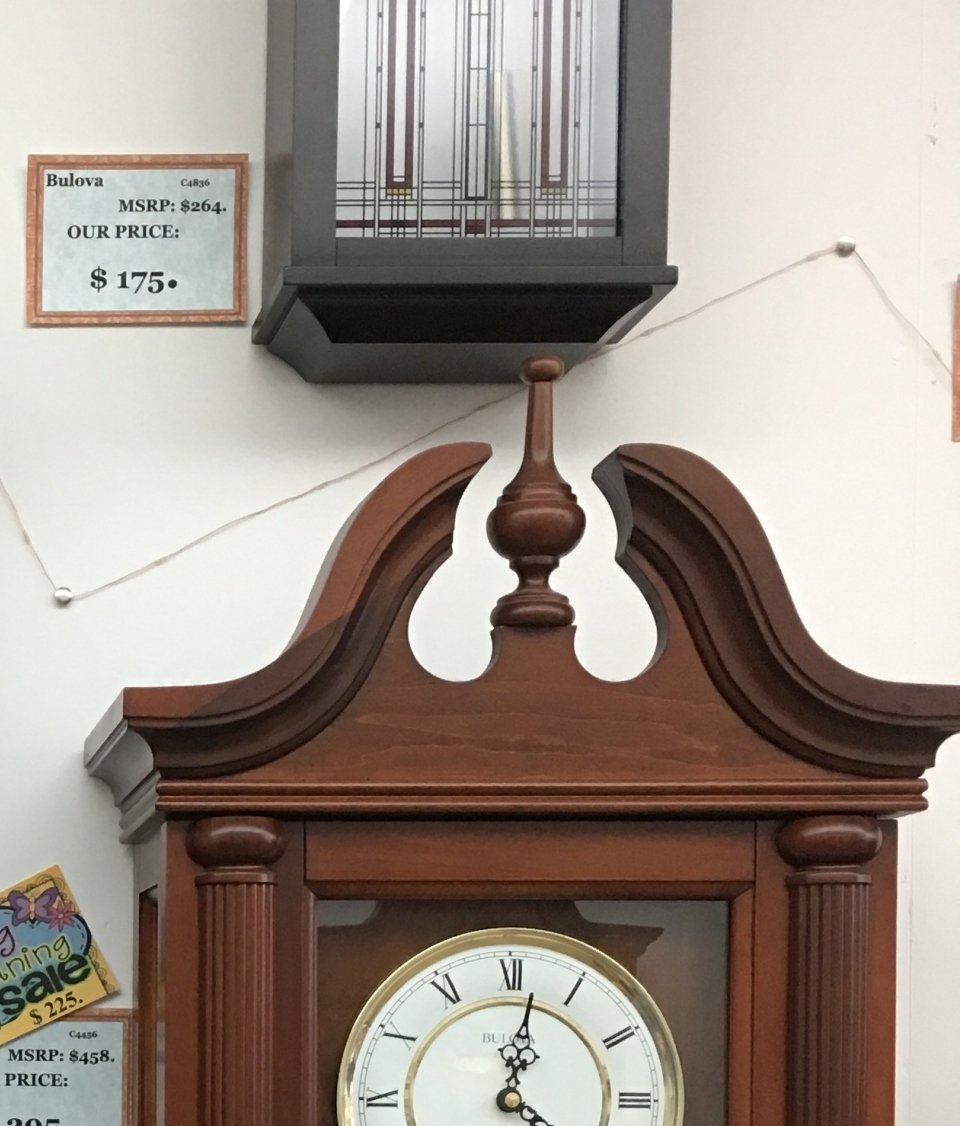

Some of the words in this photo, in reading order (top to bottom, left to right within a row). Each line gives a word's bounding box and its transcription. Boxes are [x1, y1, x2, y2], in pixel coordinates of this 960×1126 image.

[46, 172, 104, 188] Bulova
[180, 178, 211, 188] C4836
[118, 199, 175, 213] MSRP:
[180, 198, 227, 215] $264.
[67, 224, 110, 239] OUR
[115, 224, 180, 239] PRICE:
[68, 1029, 98, 1039] C4456
[7, 1049, 65, 1063] MSRP:
[68, 1048, 115, 1065] $458.
[4, 1073, 69, 1088] PRICE:
